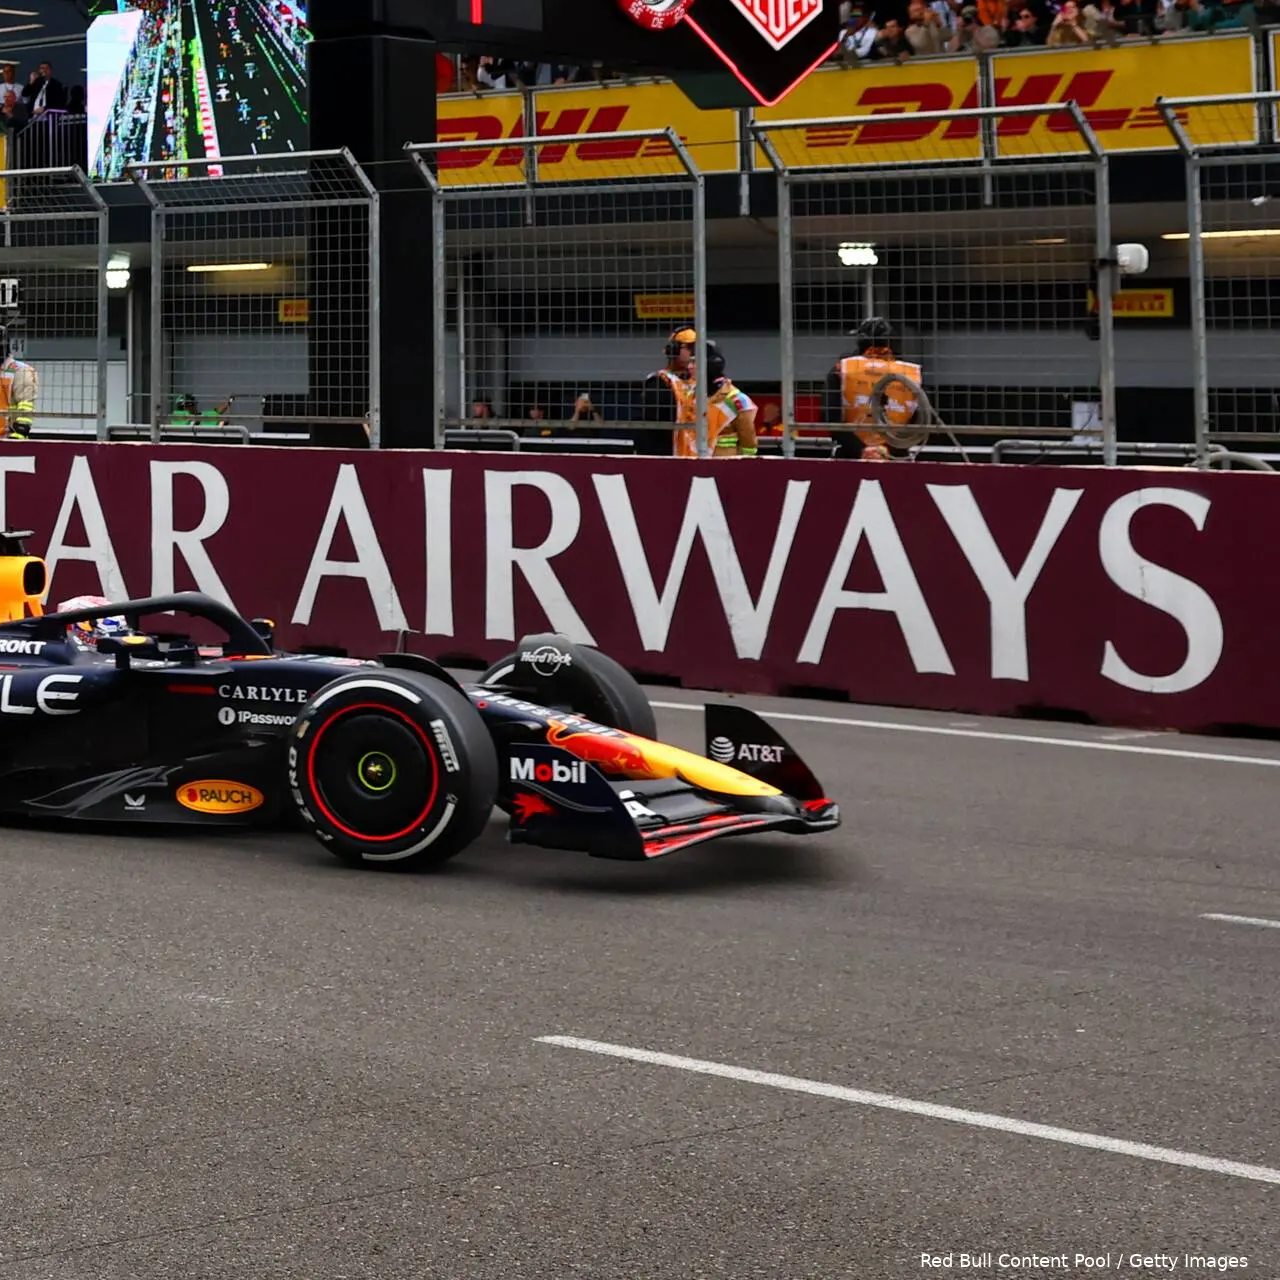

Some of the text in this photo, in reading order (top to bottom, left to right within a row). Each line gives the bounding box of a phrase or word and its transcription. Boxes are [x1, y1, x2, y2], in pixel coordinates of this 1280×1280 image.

[853, 69, 1134, 146] DHL
[437, 105, 643, 170] DHL
[291, 463, 1224, 694] AIRWAYS
[520, 651, 545, 663] Hard
[218, 685, 308, 704] CARLYLE
[738, 742, 785, 764] AT&T
[509, 756, 587, 784] Mobil
[200, 789, 253, 804] RAUCH
